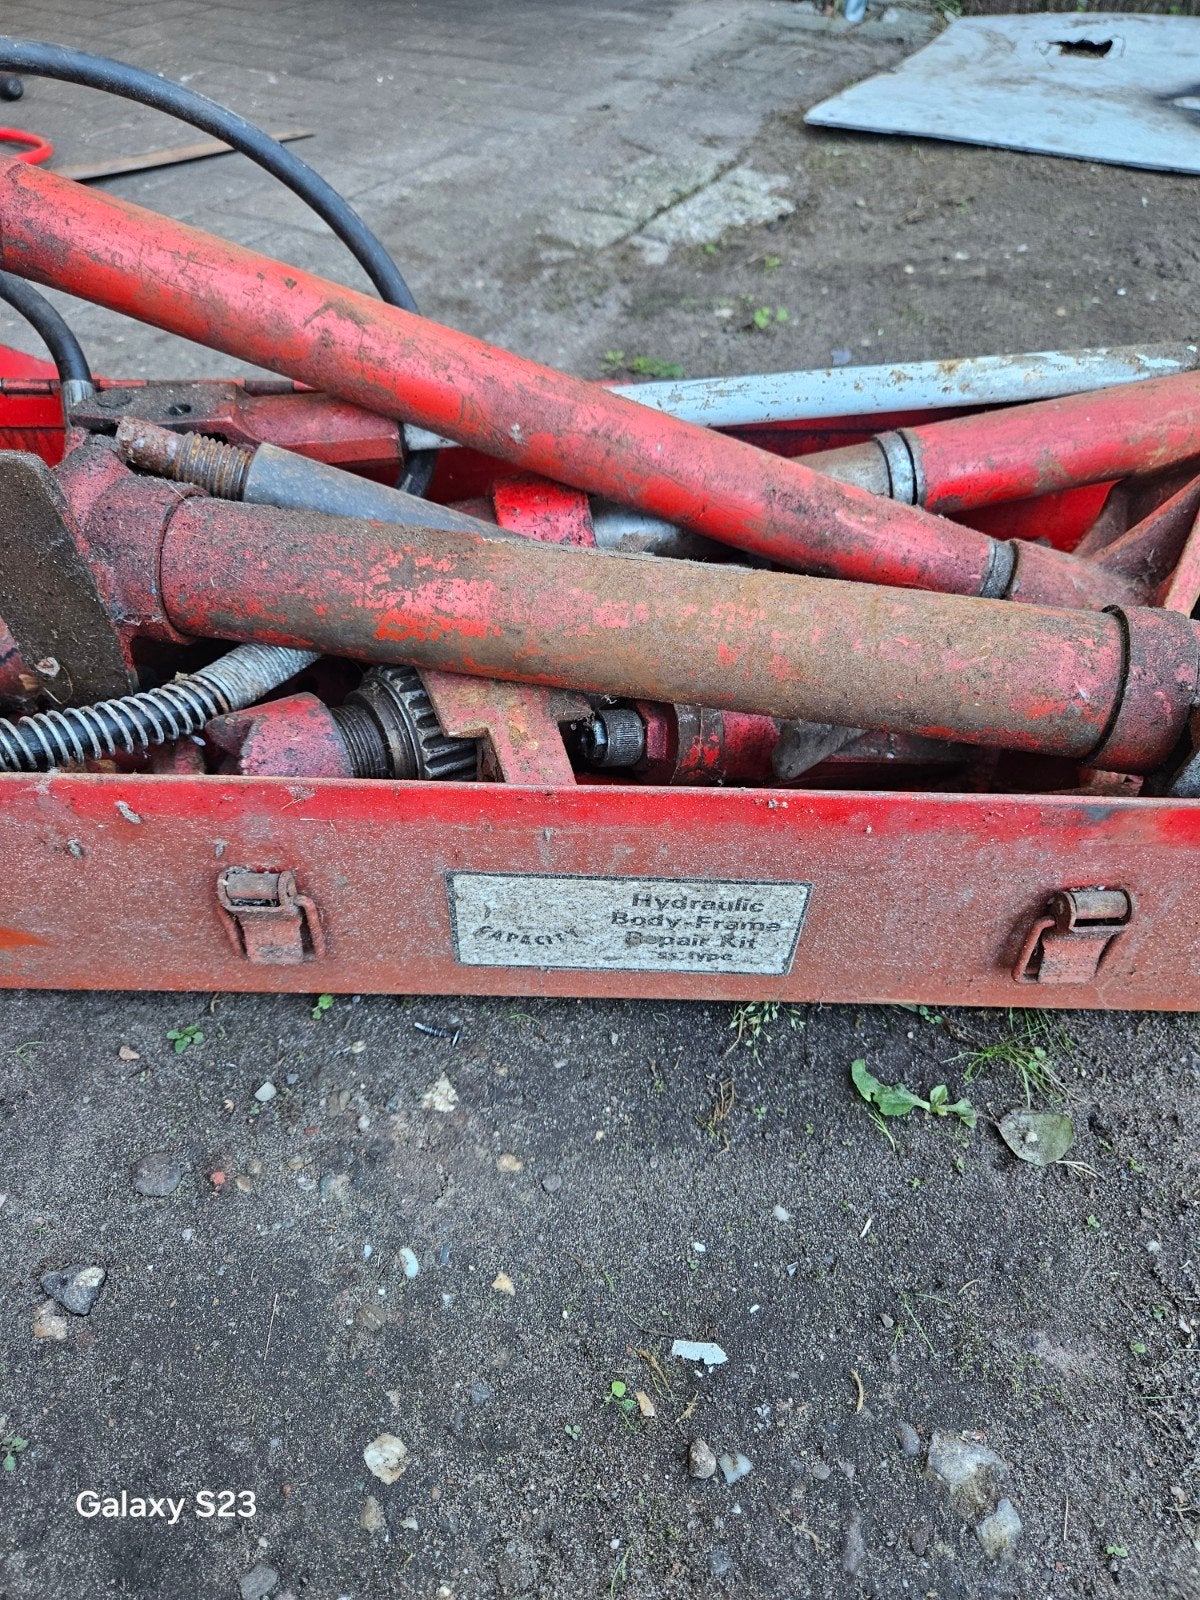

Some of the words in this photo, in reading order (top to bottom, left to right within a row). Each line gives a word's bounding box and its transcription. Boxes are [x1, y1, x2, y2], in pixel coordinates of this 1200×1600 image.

[632, 892, 765, 913] Hydraulic
[611, 910, 781, 931] Body-Frame
[720, 932, 757, 949] Kit
